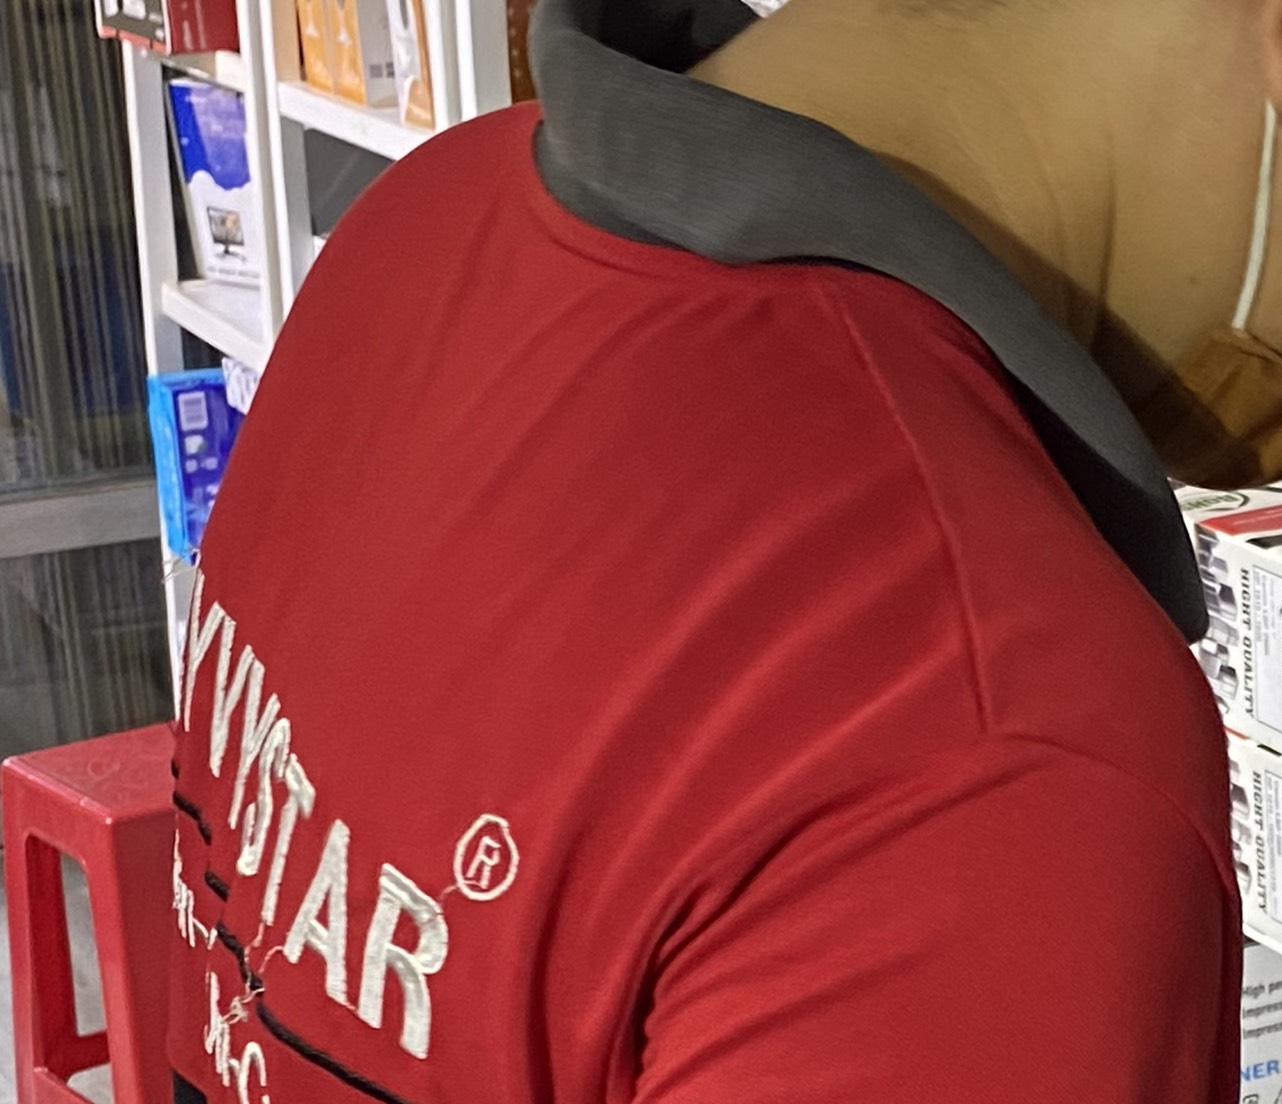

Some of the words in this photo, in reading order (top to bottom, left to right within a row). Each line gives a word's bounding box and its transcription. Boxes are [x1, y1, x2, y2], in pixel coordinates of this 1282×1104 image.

[1240, 568, 1251, 631] HIGHT
[1243, 636, 1255, 718] QUALITY
[1253, 771, 1265, 832] HIGHT
[1255, 836, 1268, 915] QUALITY
[1240, 1059, 1281, 1082] NER
